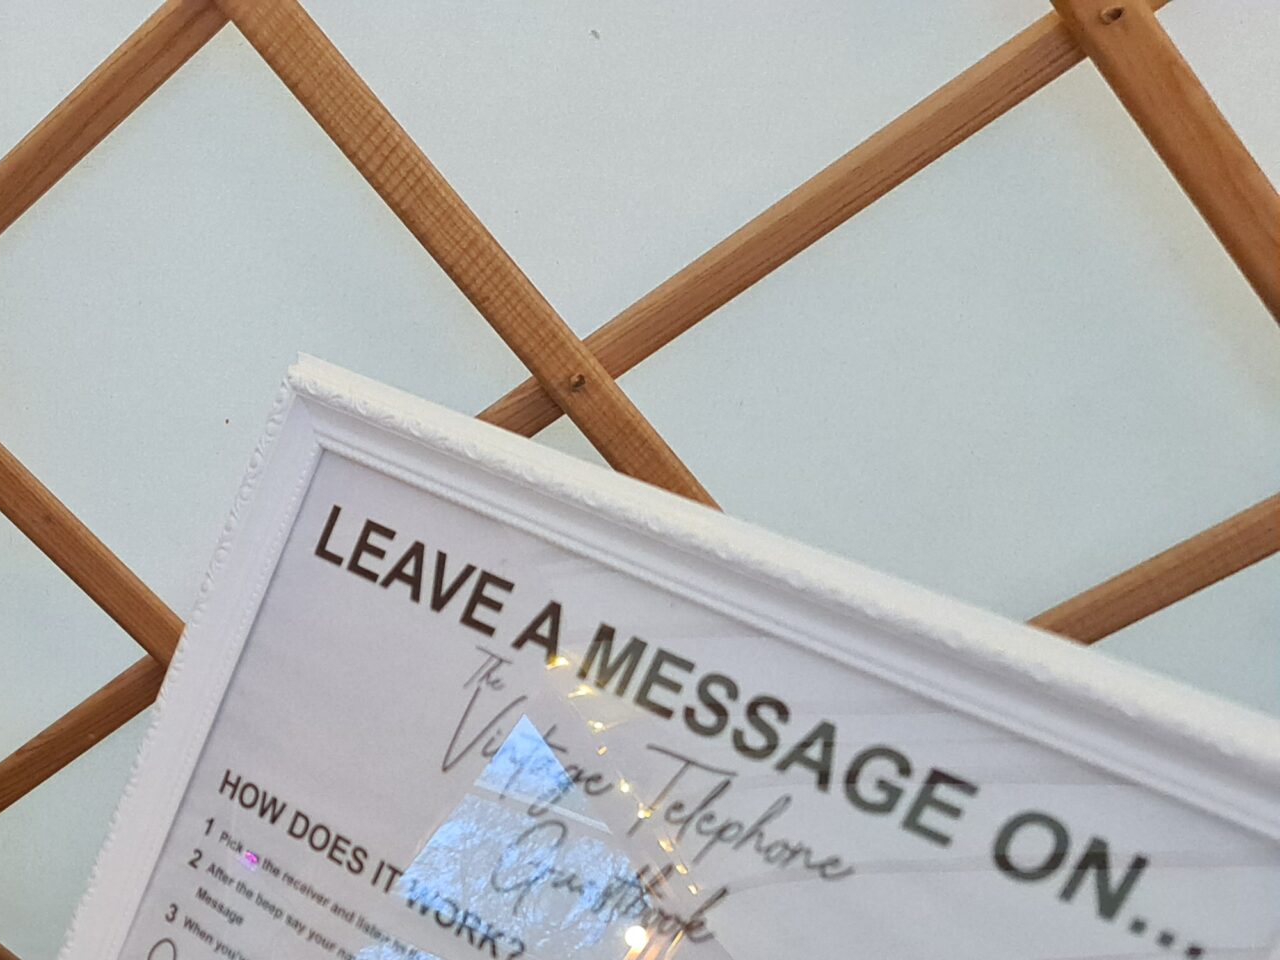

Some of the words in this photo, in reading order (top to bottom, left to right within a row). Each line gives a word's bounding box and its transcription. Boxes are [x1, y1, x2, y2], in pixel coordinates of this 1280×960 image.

[463, 645, 513, 691] The
[314, 505, 515, 637] LEAVE
[511, 600, 562, 666] A
[577, 623, 978, 847] MESSAGE
[992, 811, 1205, 960] ON...
[219, 769, 287, 825] HOW
[287, 810, 368, 875] DOES
[371, 860, 404, 893] IT
[627, 743, 856, 882] Telephone
[188, 849, 203, 869] 2
[206, 862, 234, 885] After
[235, 881, 254, 900] the
[255, 892, 284, 919] beep
[286, 914, 307, 935] say
[306, 929, 337, 951] your
[196, 886, 244, 925] Message
[205, 817, 215, 836] 1
[219, 830, 243, 854] Pick
[262, 858, 281, 877] the
[282, 872, 330, 907] receiver
[330, 903, 355, 923] and
[165, 903, 178, 923] 3
[183, 916, 214, 944] When
